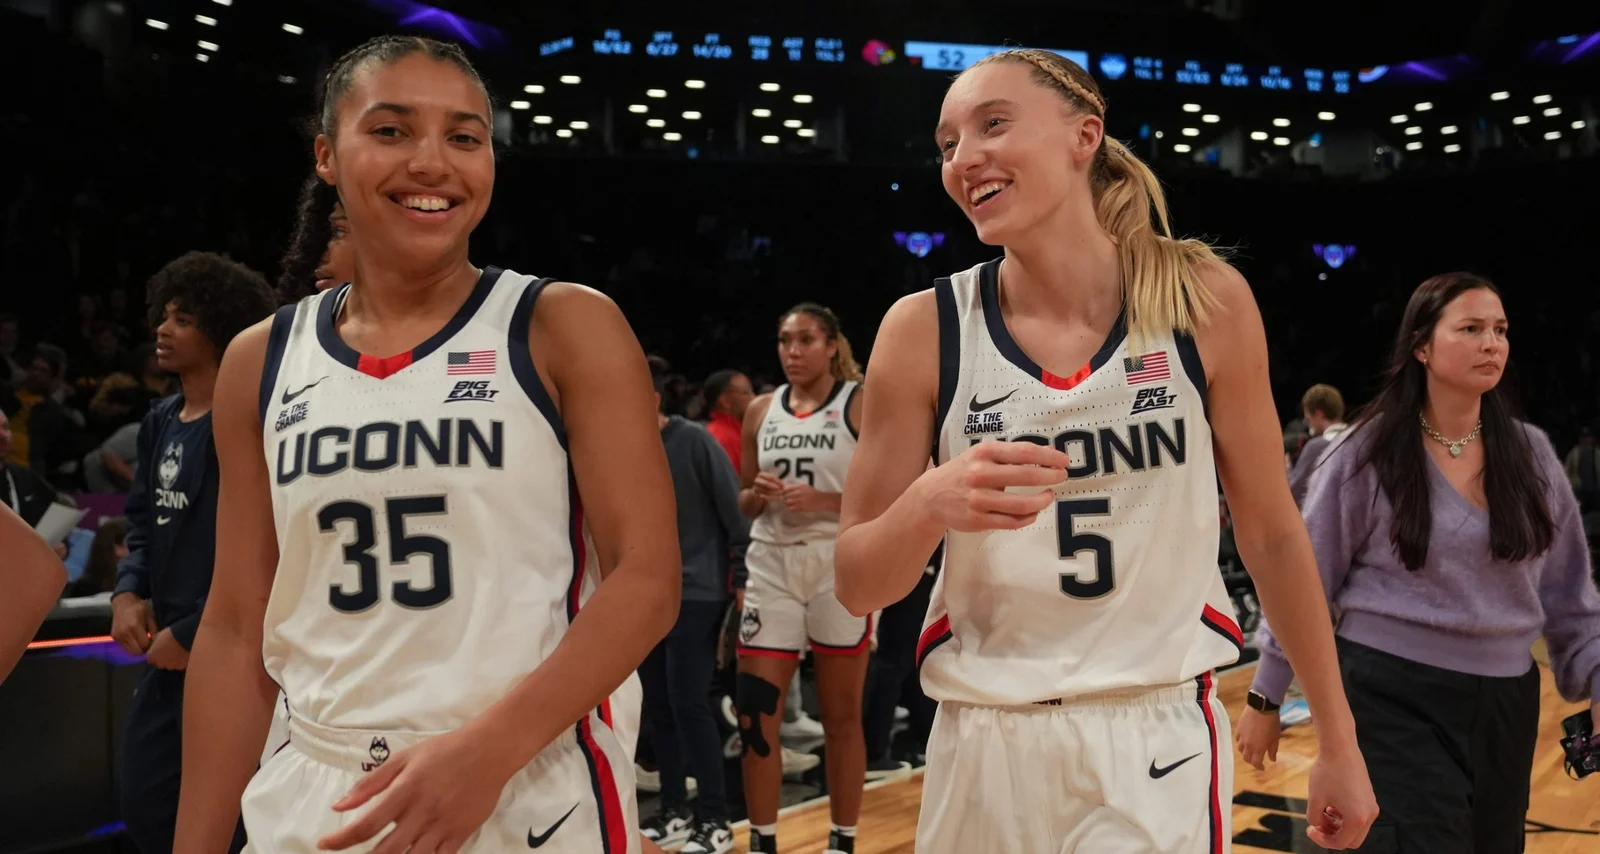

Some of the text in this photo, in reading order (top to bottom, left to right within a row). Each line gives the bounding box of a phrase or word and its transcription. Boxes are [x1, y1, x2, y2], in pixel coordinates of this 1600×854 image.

[938, 49, 964, 67] 52
[454, 381, 491, 390] BIG
[1137, 386, 1168, 397] BIG
[451, 390, 500, 400] EAST
[1132, 394, 1178, 409] EAST
[278, 401, 310, 420] BE THE
[967, 411, 1003, 425] BE THE
[274, 409, 308, 432] CHANGE
[963, 421, 1005, 436] CHANGE
[763, 434, 835, 451] UCONN
[969, 416, 1188, 482] ONN
[276, 417, 504, 487] UCONN
[316, 493, 454, 615] 35
[1055, 496, 1117, 601] 5
